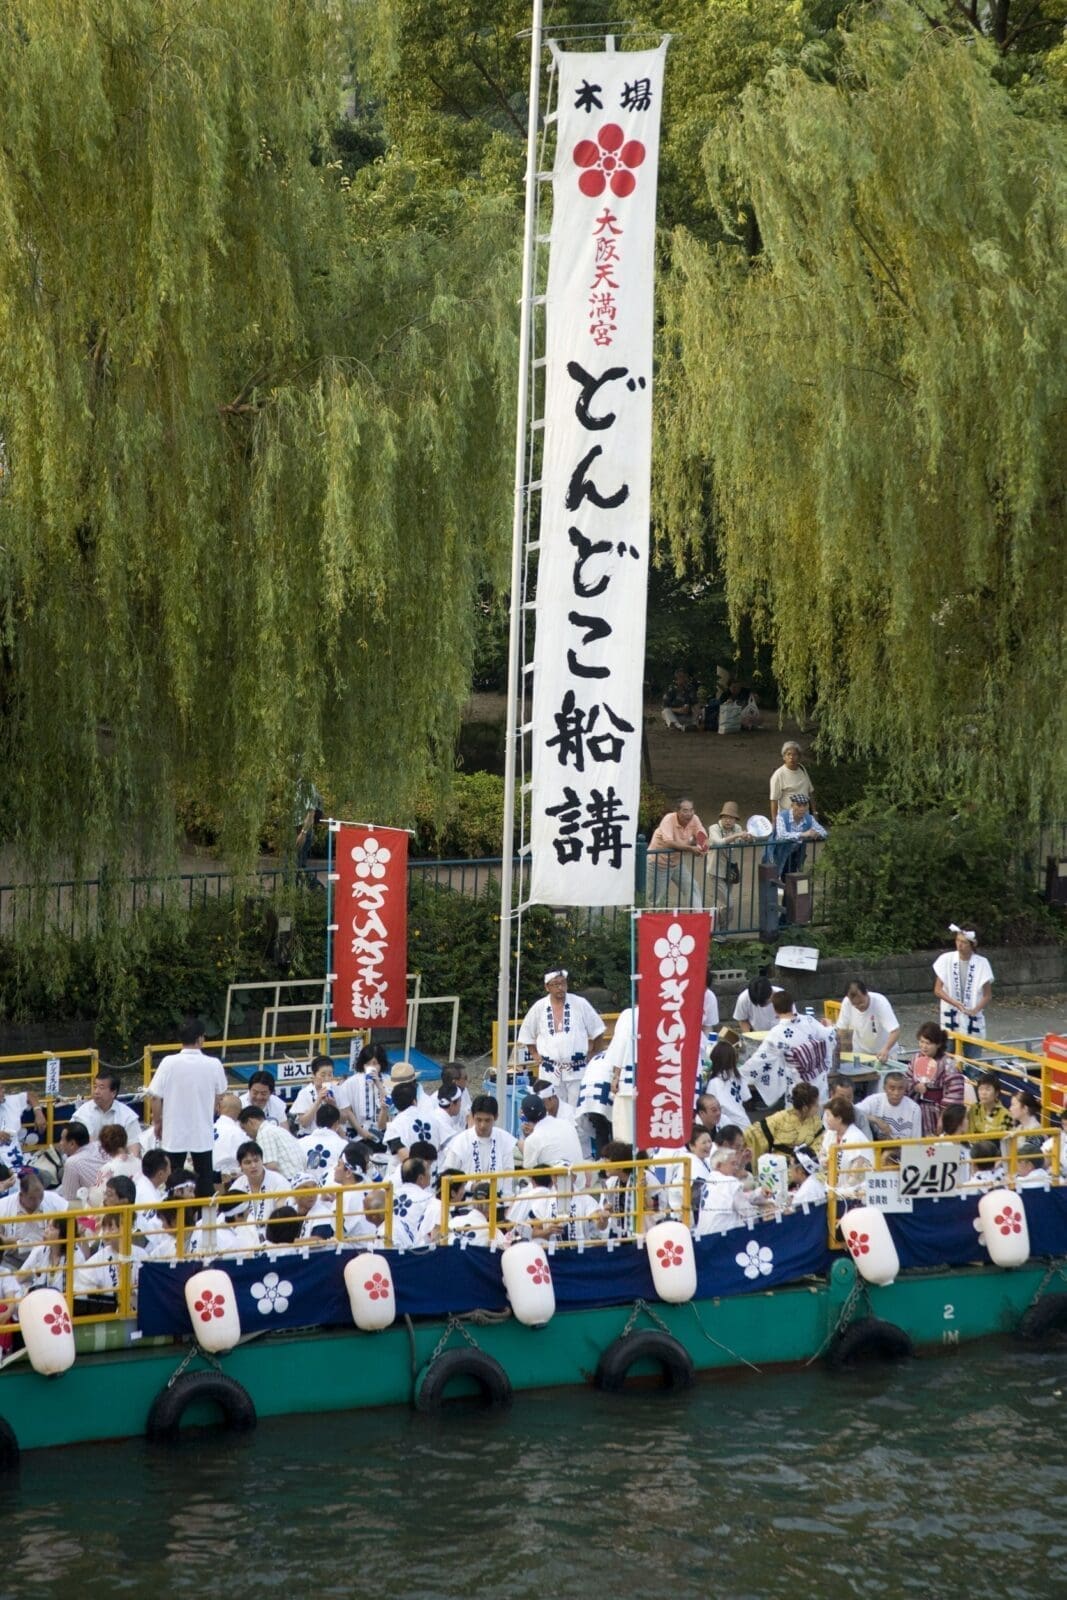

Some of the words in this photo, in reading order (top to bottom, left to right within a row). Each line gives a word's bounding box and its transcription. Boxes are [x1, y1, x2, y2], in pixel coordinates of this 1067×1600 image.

[574, 78, 653, 113] 木場
[588, 208, 623, 347] 大阪天満宮
[545, 361, 646, 869] どんどこ船講
[284, 1064, 312, 1077] 出入口
[901, 1162, 958, 1195] 24B
[943, 1304, 955, 1319] 2
